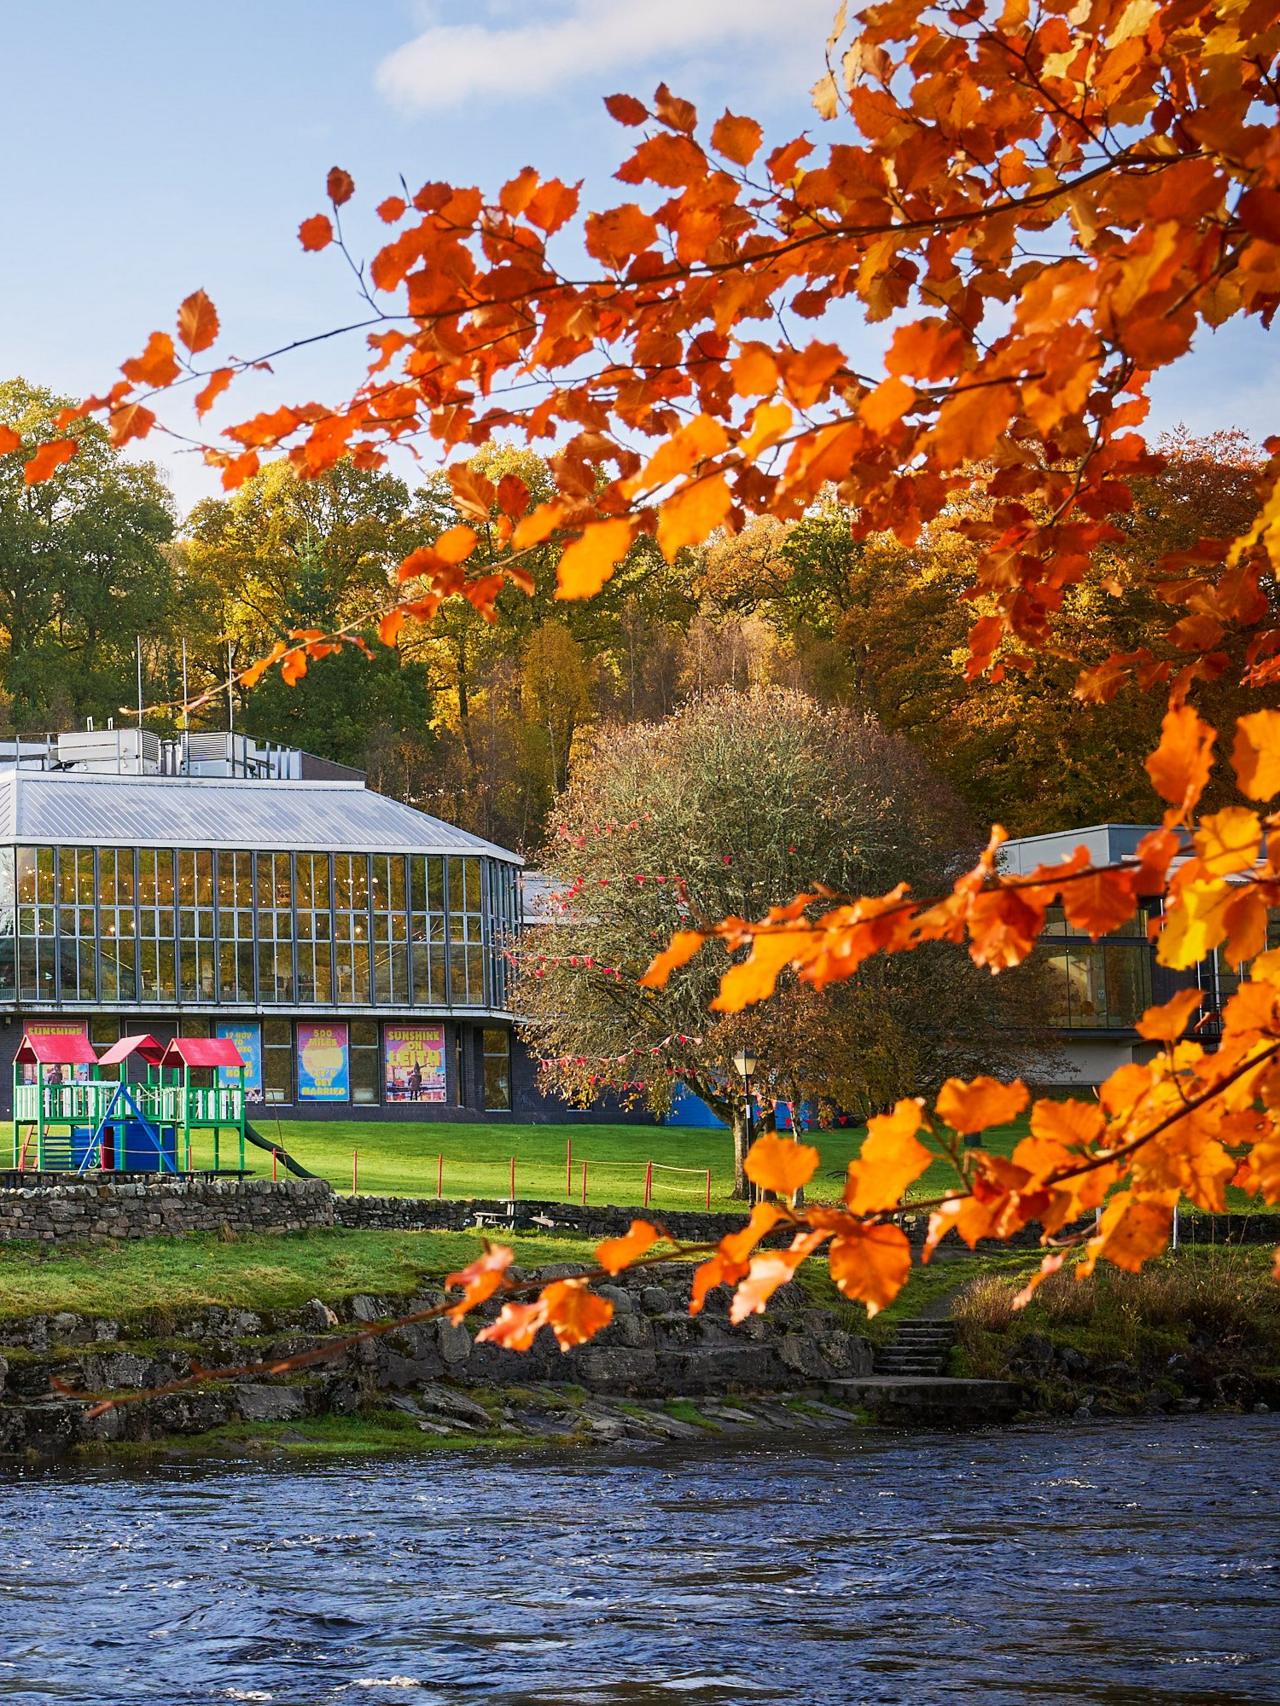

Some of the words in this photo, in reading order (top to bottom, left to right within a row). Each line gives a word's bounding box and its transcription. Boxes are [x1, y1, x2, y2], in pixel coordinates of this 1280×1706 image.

[28, 1028, 82, 1036] SUNSHINE
[387, 1031, 440, 1041] SUNSHINE
[408, 1041, 423, 1050] ON
[389, 1050, 442, 1067] LEITH
